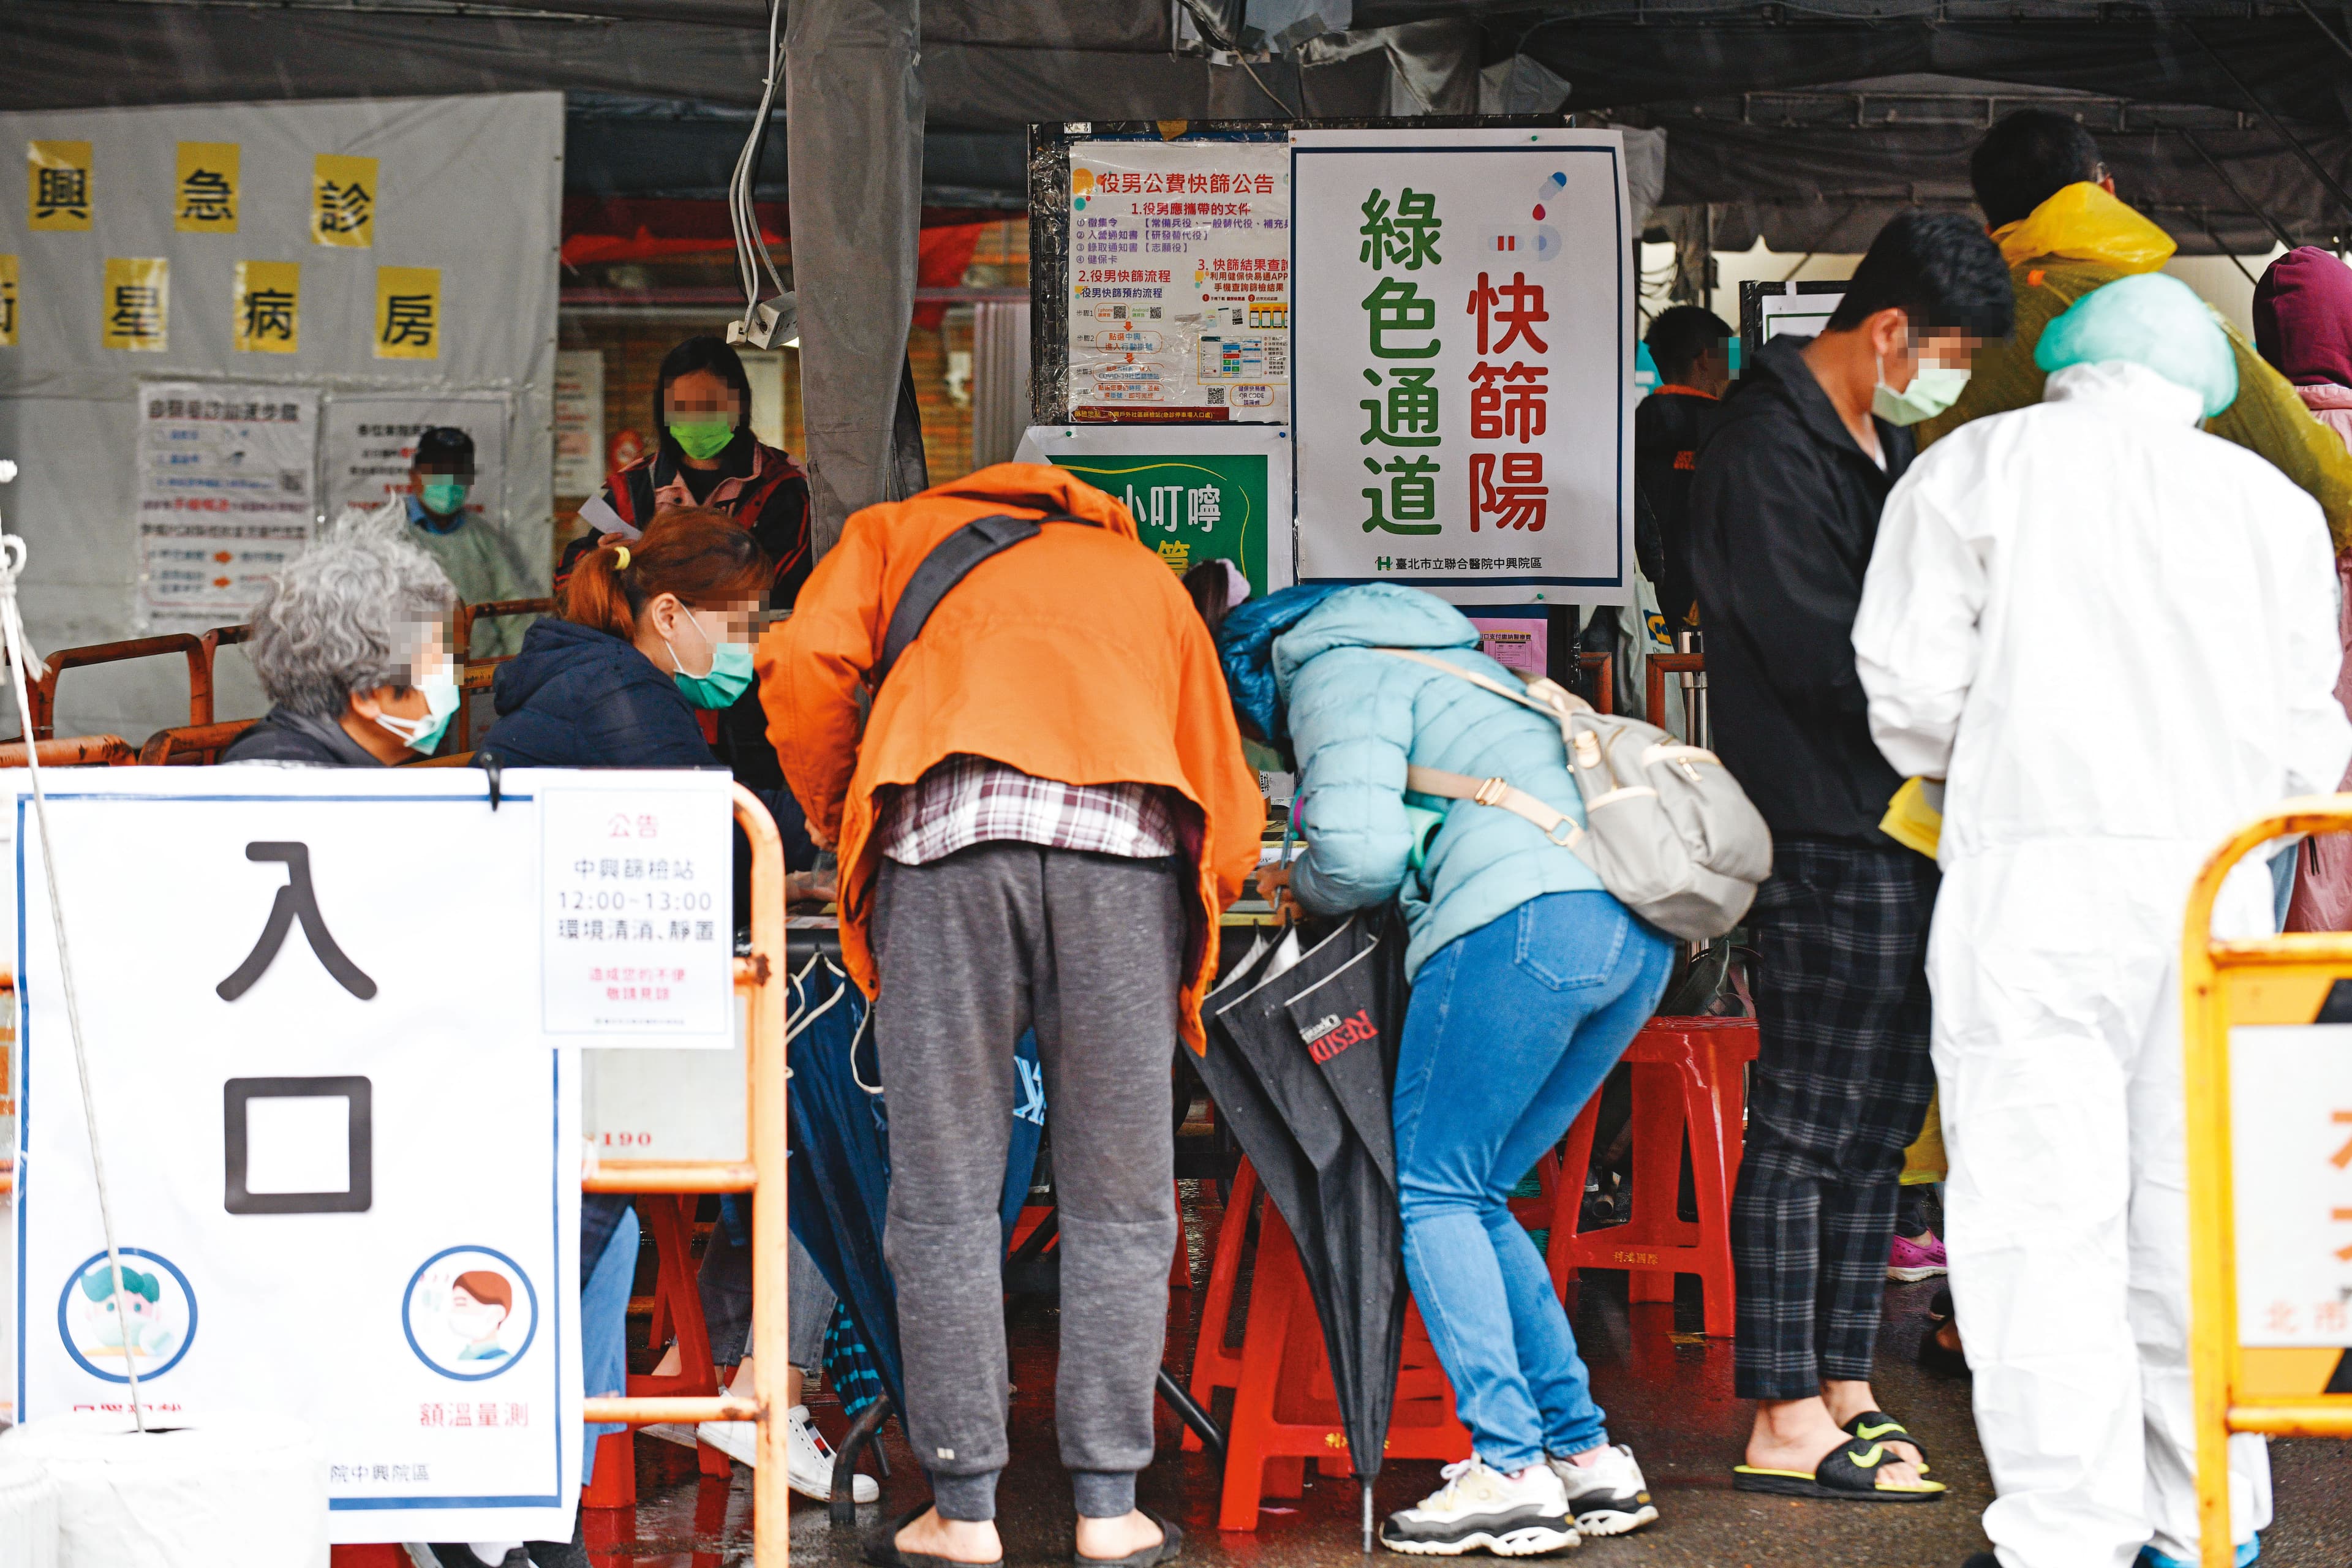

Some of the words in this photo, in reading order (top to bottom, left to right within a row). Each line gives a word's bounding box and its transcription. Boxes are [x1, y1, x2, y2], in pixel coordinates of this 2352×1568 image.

[1102, 173, 1275, 194] 役男公費快篩公告
[1088, 230, 1138, 240] 入營通知書
[1088, 243, 1138, 252] 錄取通知書
[1088, 255, 1117, 264] 健保卡
[1078, 270, 1170, 283] 2.役男快篩流程
[1082, 288, 1163, 298] 役男快篩預約流程
[1215, 282, 1284, 292] 手機查詢篩檢結果
[1360, 187, 1442, 536] 綠色通道
[1466, 272, 1550, 532] 快篩陽
[1396, 557, 1542, 570] 臺北市立聯合醫院中興院區
[608, 813, 659, 839] 公告
[575, 858, 694, 880] 中興篩檢站
[216, 841, 377, 1215] 入口
[420, 1402, 529, 1428] 額溫量測
